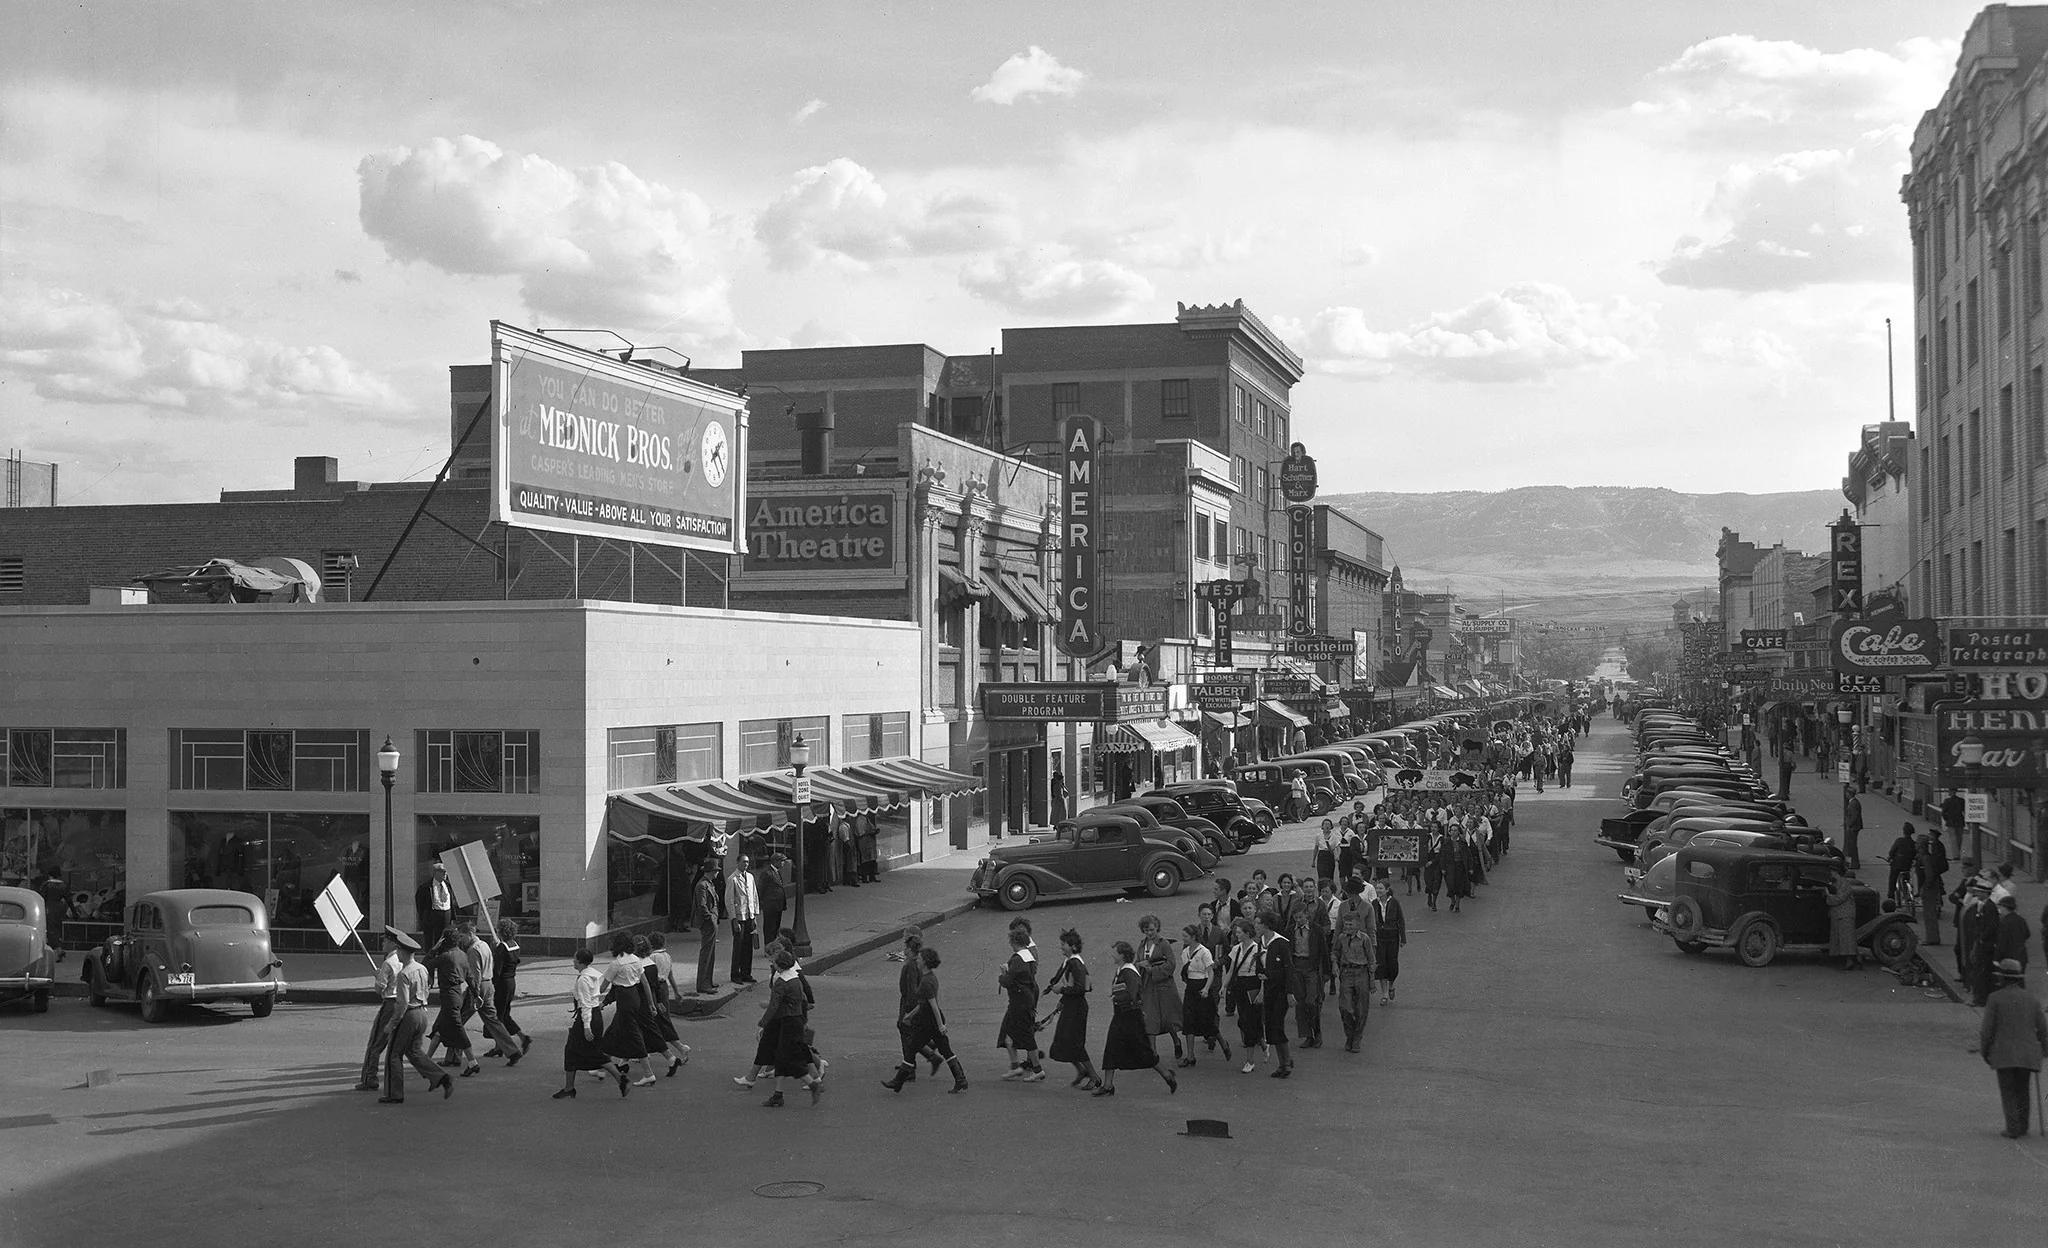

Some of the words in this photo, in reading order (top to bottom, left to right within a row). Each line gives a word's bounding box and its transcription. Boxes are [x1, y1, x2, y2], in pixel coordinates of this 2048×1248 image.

[538, 374, 564, 400] YOU
[572, 383, 596, 408] CAN
[602, 391, 619, 414] DO
[624, 397, 666, 425] BETTER
[519, 403, 539, 440] at
[539, 403, 620, 463] MEDNICK
[627, 424, 673, 471] BROS.
[531, 454, 575, 478] CASPER'S
[578, 463, 615, 484] LEADING
[619, 471, 645, 490] MEN'S
[648, 477, 674, 495] STORE
[1288, 464, 1309, 472] Hart
[1288, 489, 1308, 497] Marx
[519, 490, 560, 511] QUALITY
[565, 497, 593, 516] VALUE
[599, 503, 627, 521] ABOVE
[650, 511, 672, 528] YOUR
[675, 515, 727, 536] SATISFACTION
[750, 496, 889, 529] America
[1069, 428, 1090, 643] AMERICA
[751, 531, 886, 562] Theatre
[1293, 509, 1304, 633] CLOTHING
[1836, 532, 1857, 609] REX
[1200, 584, 1245, 596] WEST
[1218, 598, 1228, 663] HOTEL
[1286, 640, 1354, 652] Florsheim
[1746, 637, 1783, 648] CAFE
[1840, 625, 1928, 663] Cafe
[1967, 632, 2032, 646] Postal
[1307, 652, 1333, 661] SHOE
[1952, 647, 2047, 664] Telegraph
[1192, 686, 1247, 696] TALBERT
[1770, 678, 1809, 693] Daily
[1809, 678, 1834, 691] New
[1840, 684, 1881, 693] CAFE
[1001, 693, 1036, 703] DOUBLE
[1045, 693, 1087, 703] FEATURE
[1022, 706, 1065, 716] PROGRAM
[1425, 781, 1449, 789] CLASH!
[1968, 812, 1985, 820] QUIET
